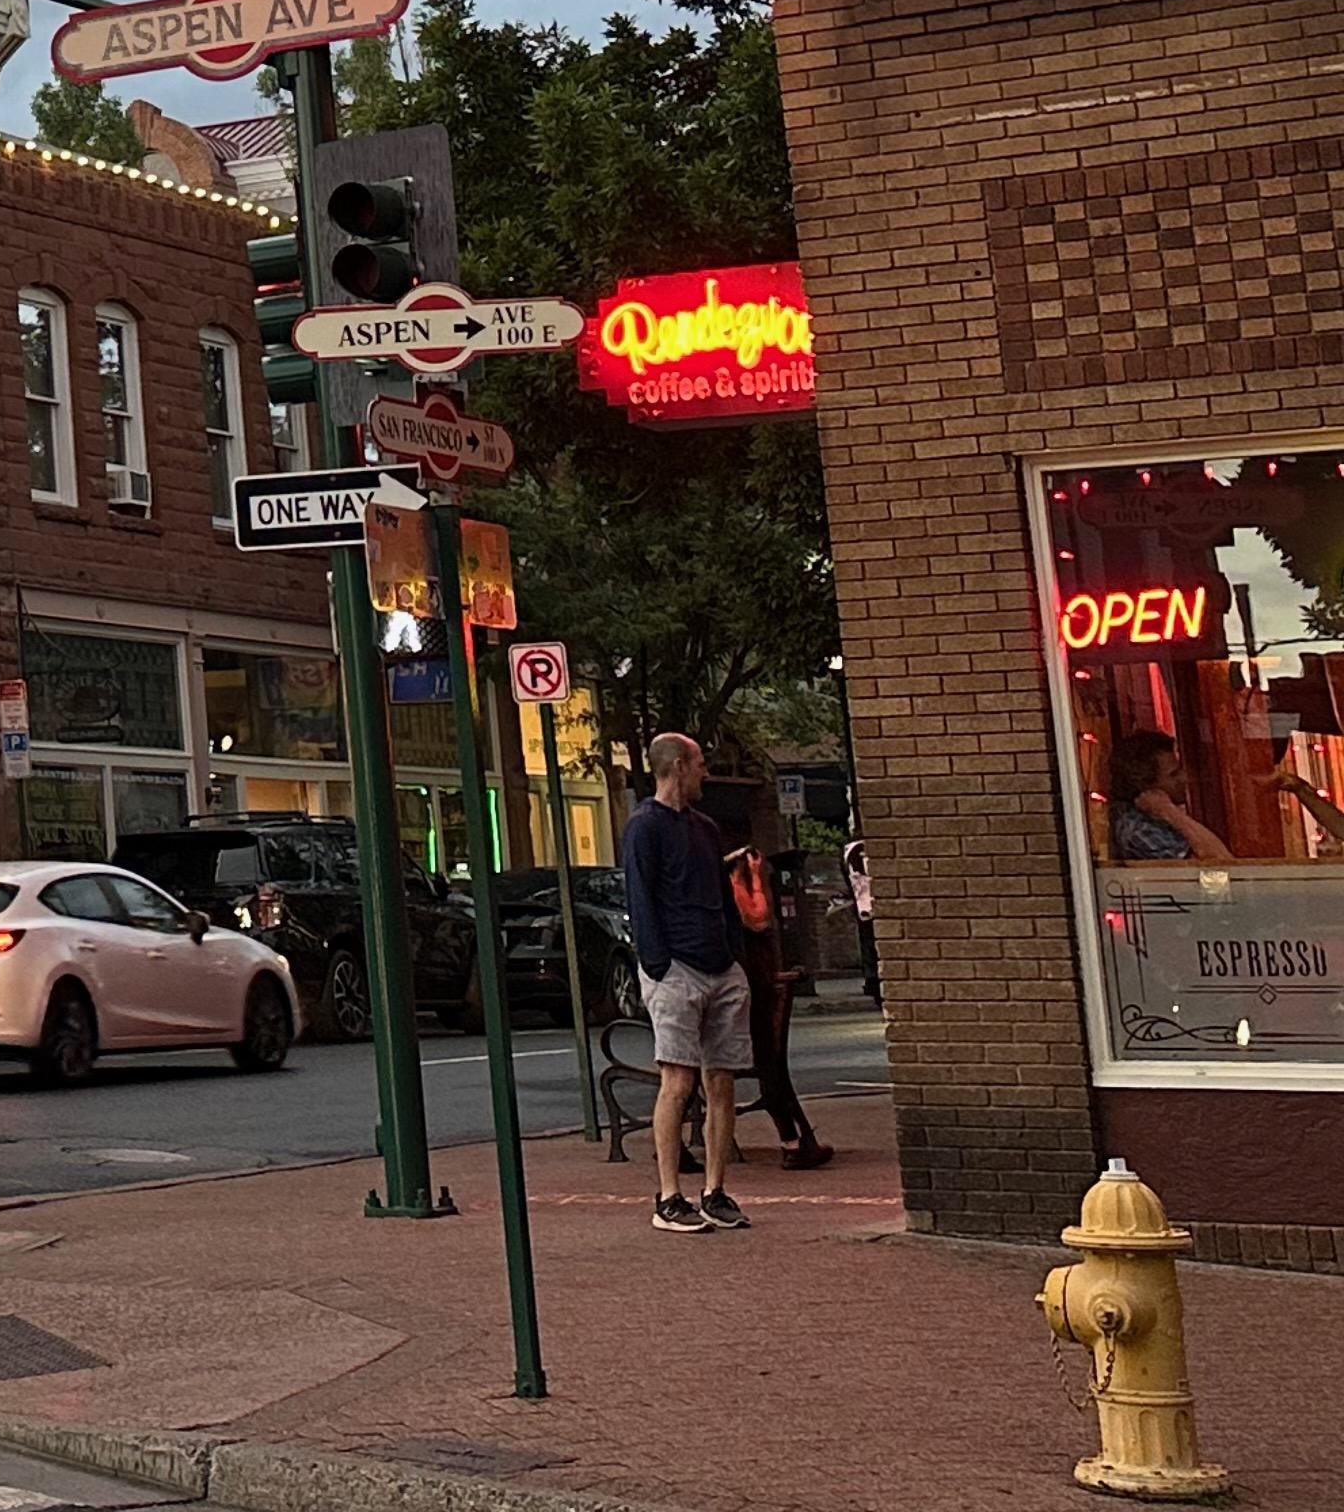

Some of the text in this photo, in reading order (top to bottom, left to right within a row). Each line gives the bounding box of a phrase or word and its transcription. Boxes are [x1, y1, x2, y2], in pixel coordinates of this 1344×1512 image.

[101, 1, 245, 62] ASPEN
[490, 304, 536, 326] AVE
[338, 318, 432, 348] ASPEN
[496, 324, 558, 346] 100 E
[627, 360, 816, 405] coffee & spirit
[378, 412, 462, 453] SAN FRANCISCO
[483, 425, 495, 443] ST
[257, 496, 311, 525] ONE
[1062, 586, 1206, 649] OPEN
[1196, 939, 1328, 978] ESPRESSO
